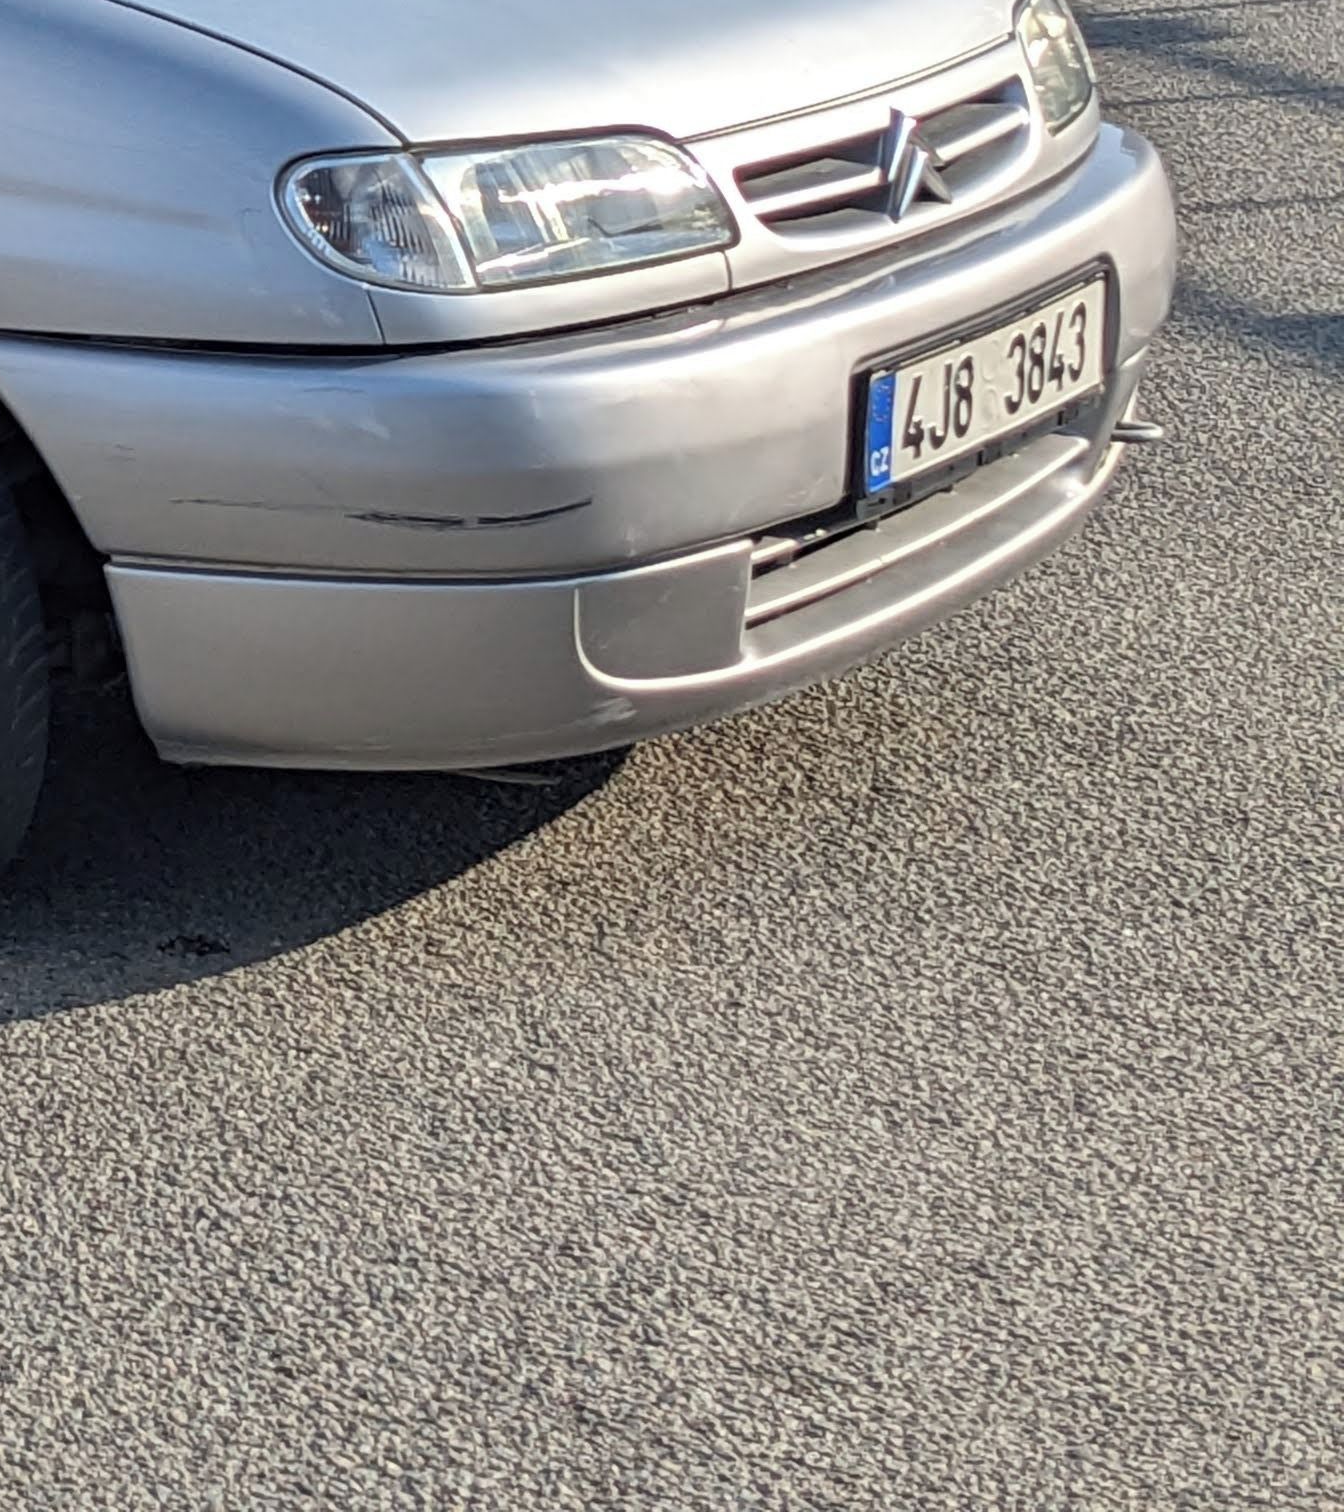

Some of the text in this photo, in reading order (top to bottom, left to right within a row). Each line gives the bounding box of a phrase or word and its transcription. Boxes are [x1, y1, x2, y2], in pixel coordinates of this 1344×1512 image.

[900, 301, 1087, 460] 4J8 3843
[869, 445, 890, 477] CZ
